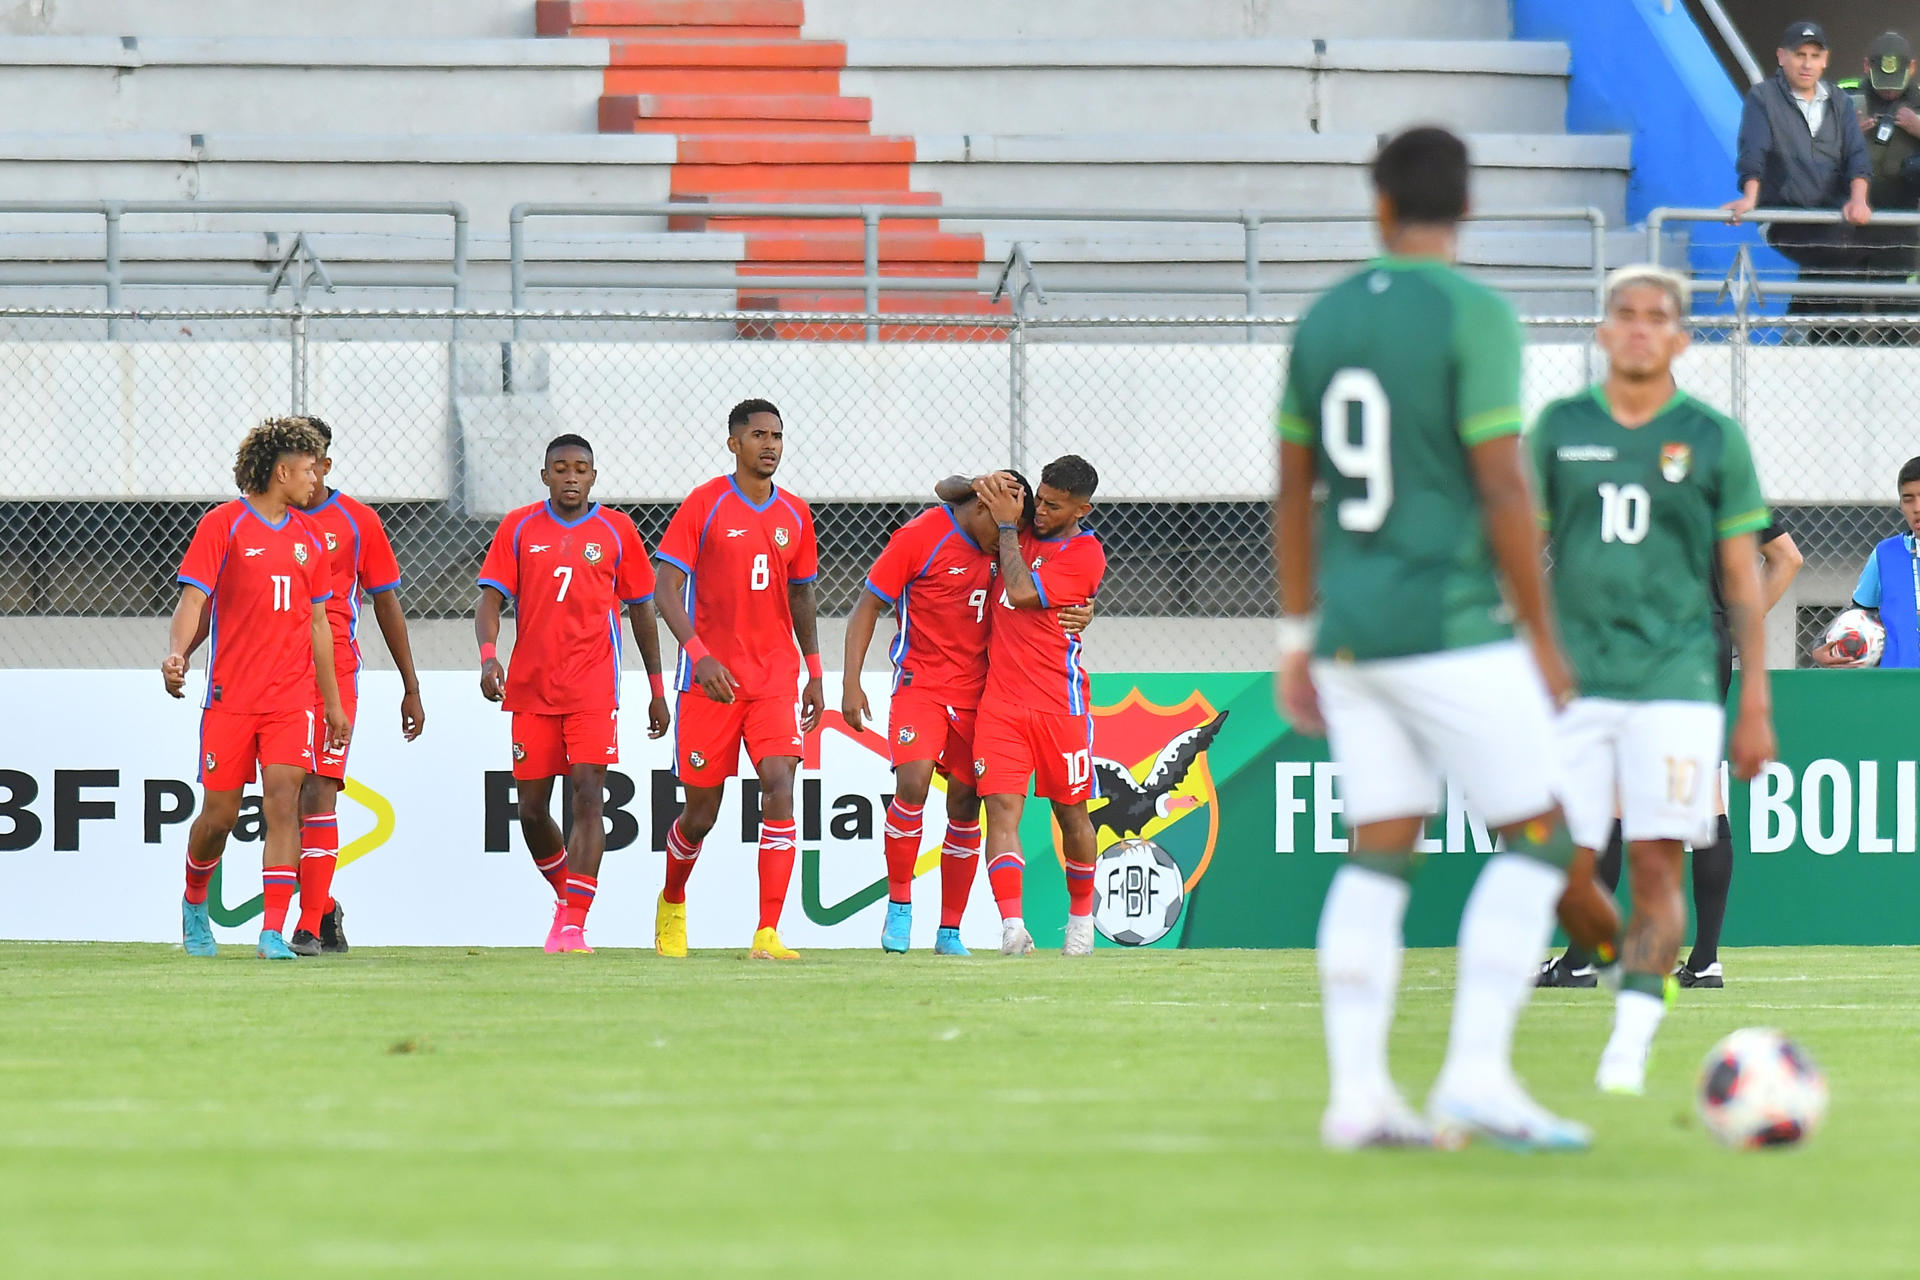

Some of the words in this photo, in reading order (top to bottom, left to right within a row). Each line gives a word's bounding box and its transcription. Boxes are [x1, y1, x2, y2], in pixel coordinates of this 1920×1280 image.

[1321, 366, 1394, 532] 9
[1598, 482, 1651, 544] 10
[271, 575, 291, 612] 11
[553, 566, 573, 602] 7
[751, 553, 769, 591] 8
[968, 589, 987, 624] 9
[1062, 749, 1090, 786] 10
[1664, 755, 1700, 807] 10
[1749, 758, 1916, 856] BOLI
[1107, 865, 1161, 918] FBF
